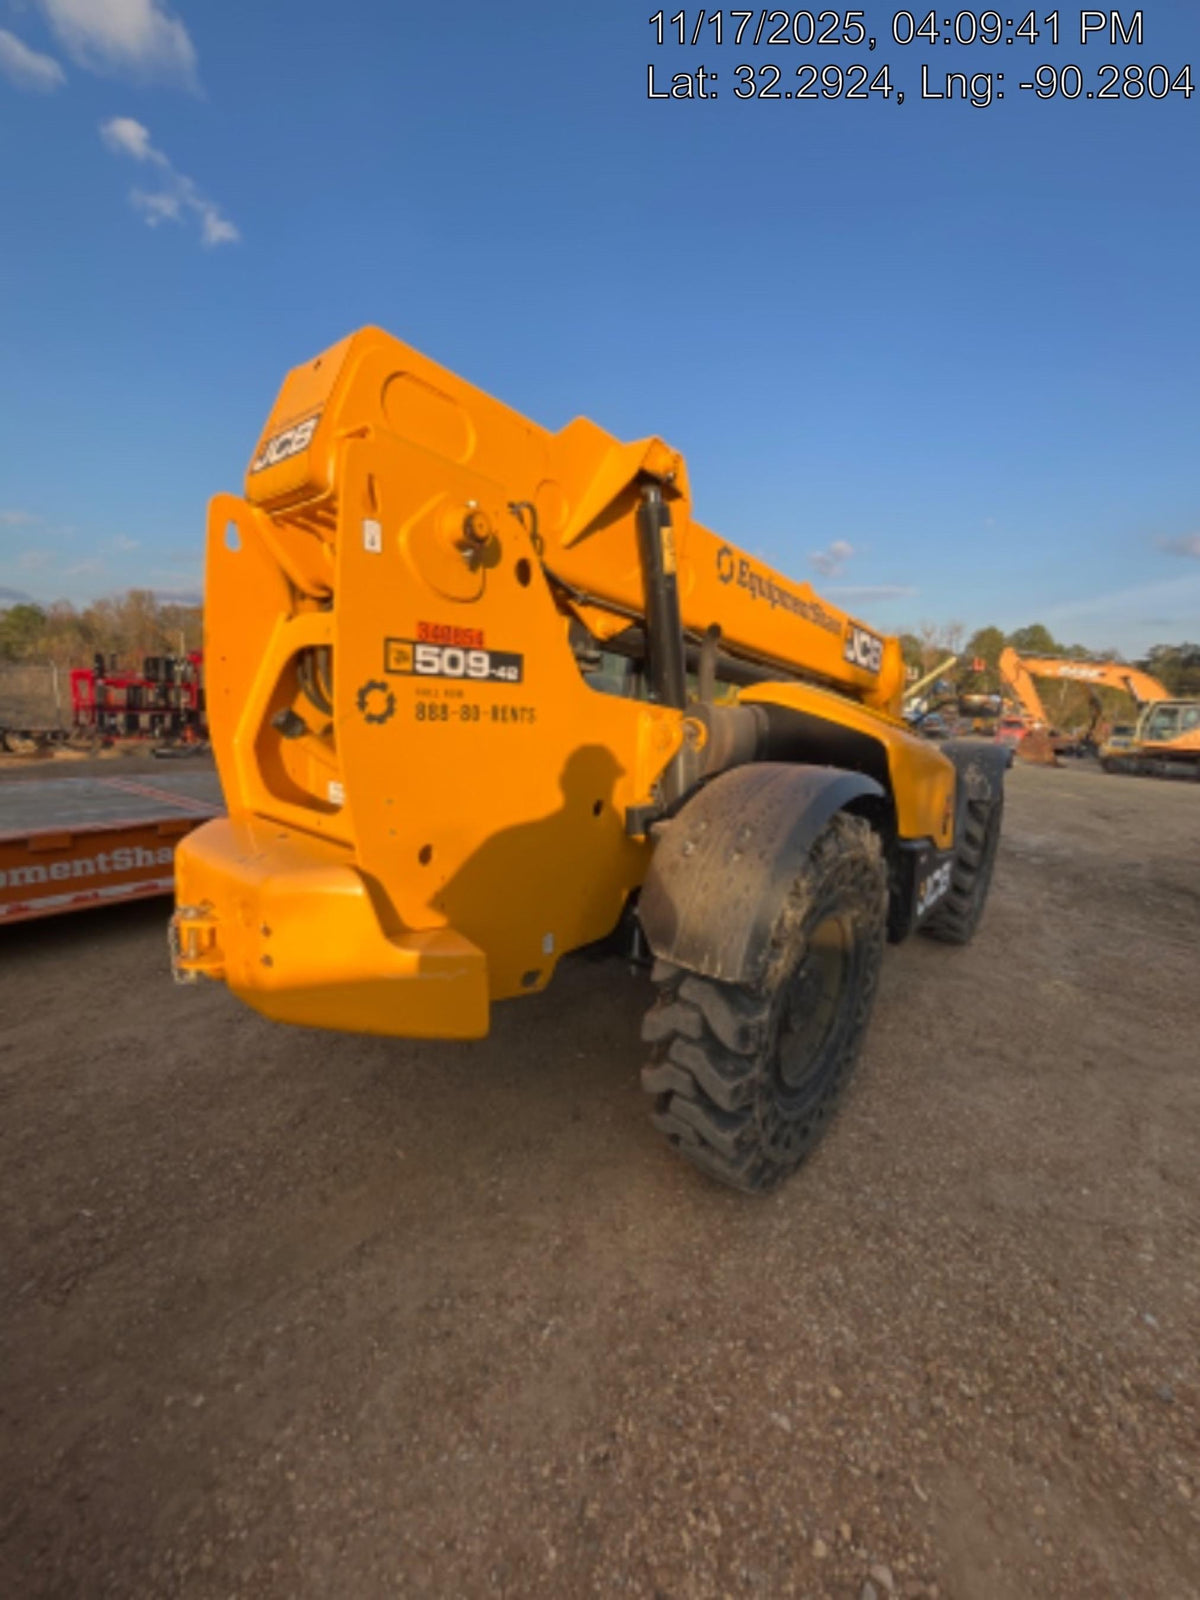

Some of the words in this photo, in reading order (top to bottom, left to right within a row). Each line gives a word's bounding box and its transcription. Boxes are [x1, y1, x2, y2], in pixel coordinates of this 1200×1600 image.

[251, 416, 320, 473] JCB
[737, 556, 843, 638] Equipment
[845, 625, 883, 672] JCB
